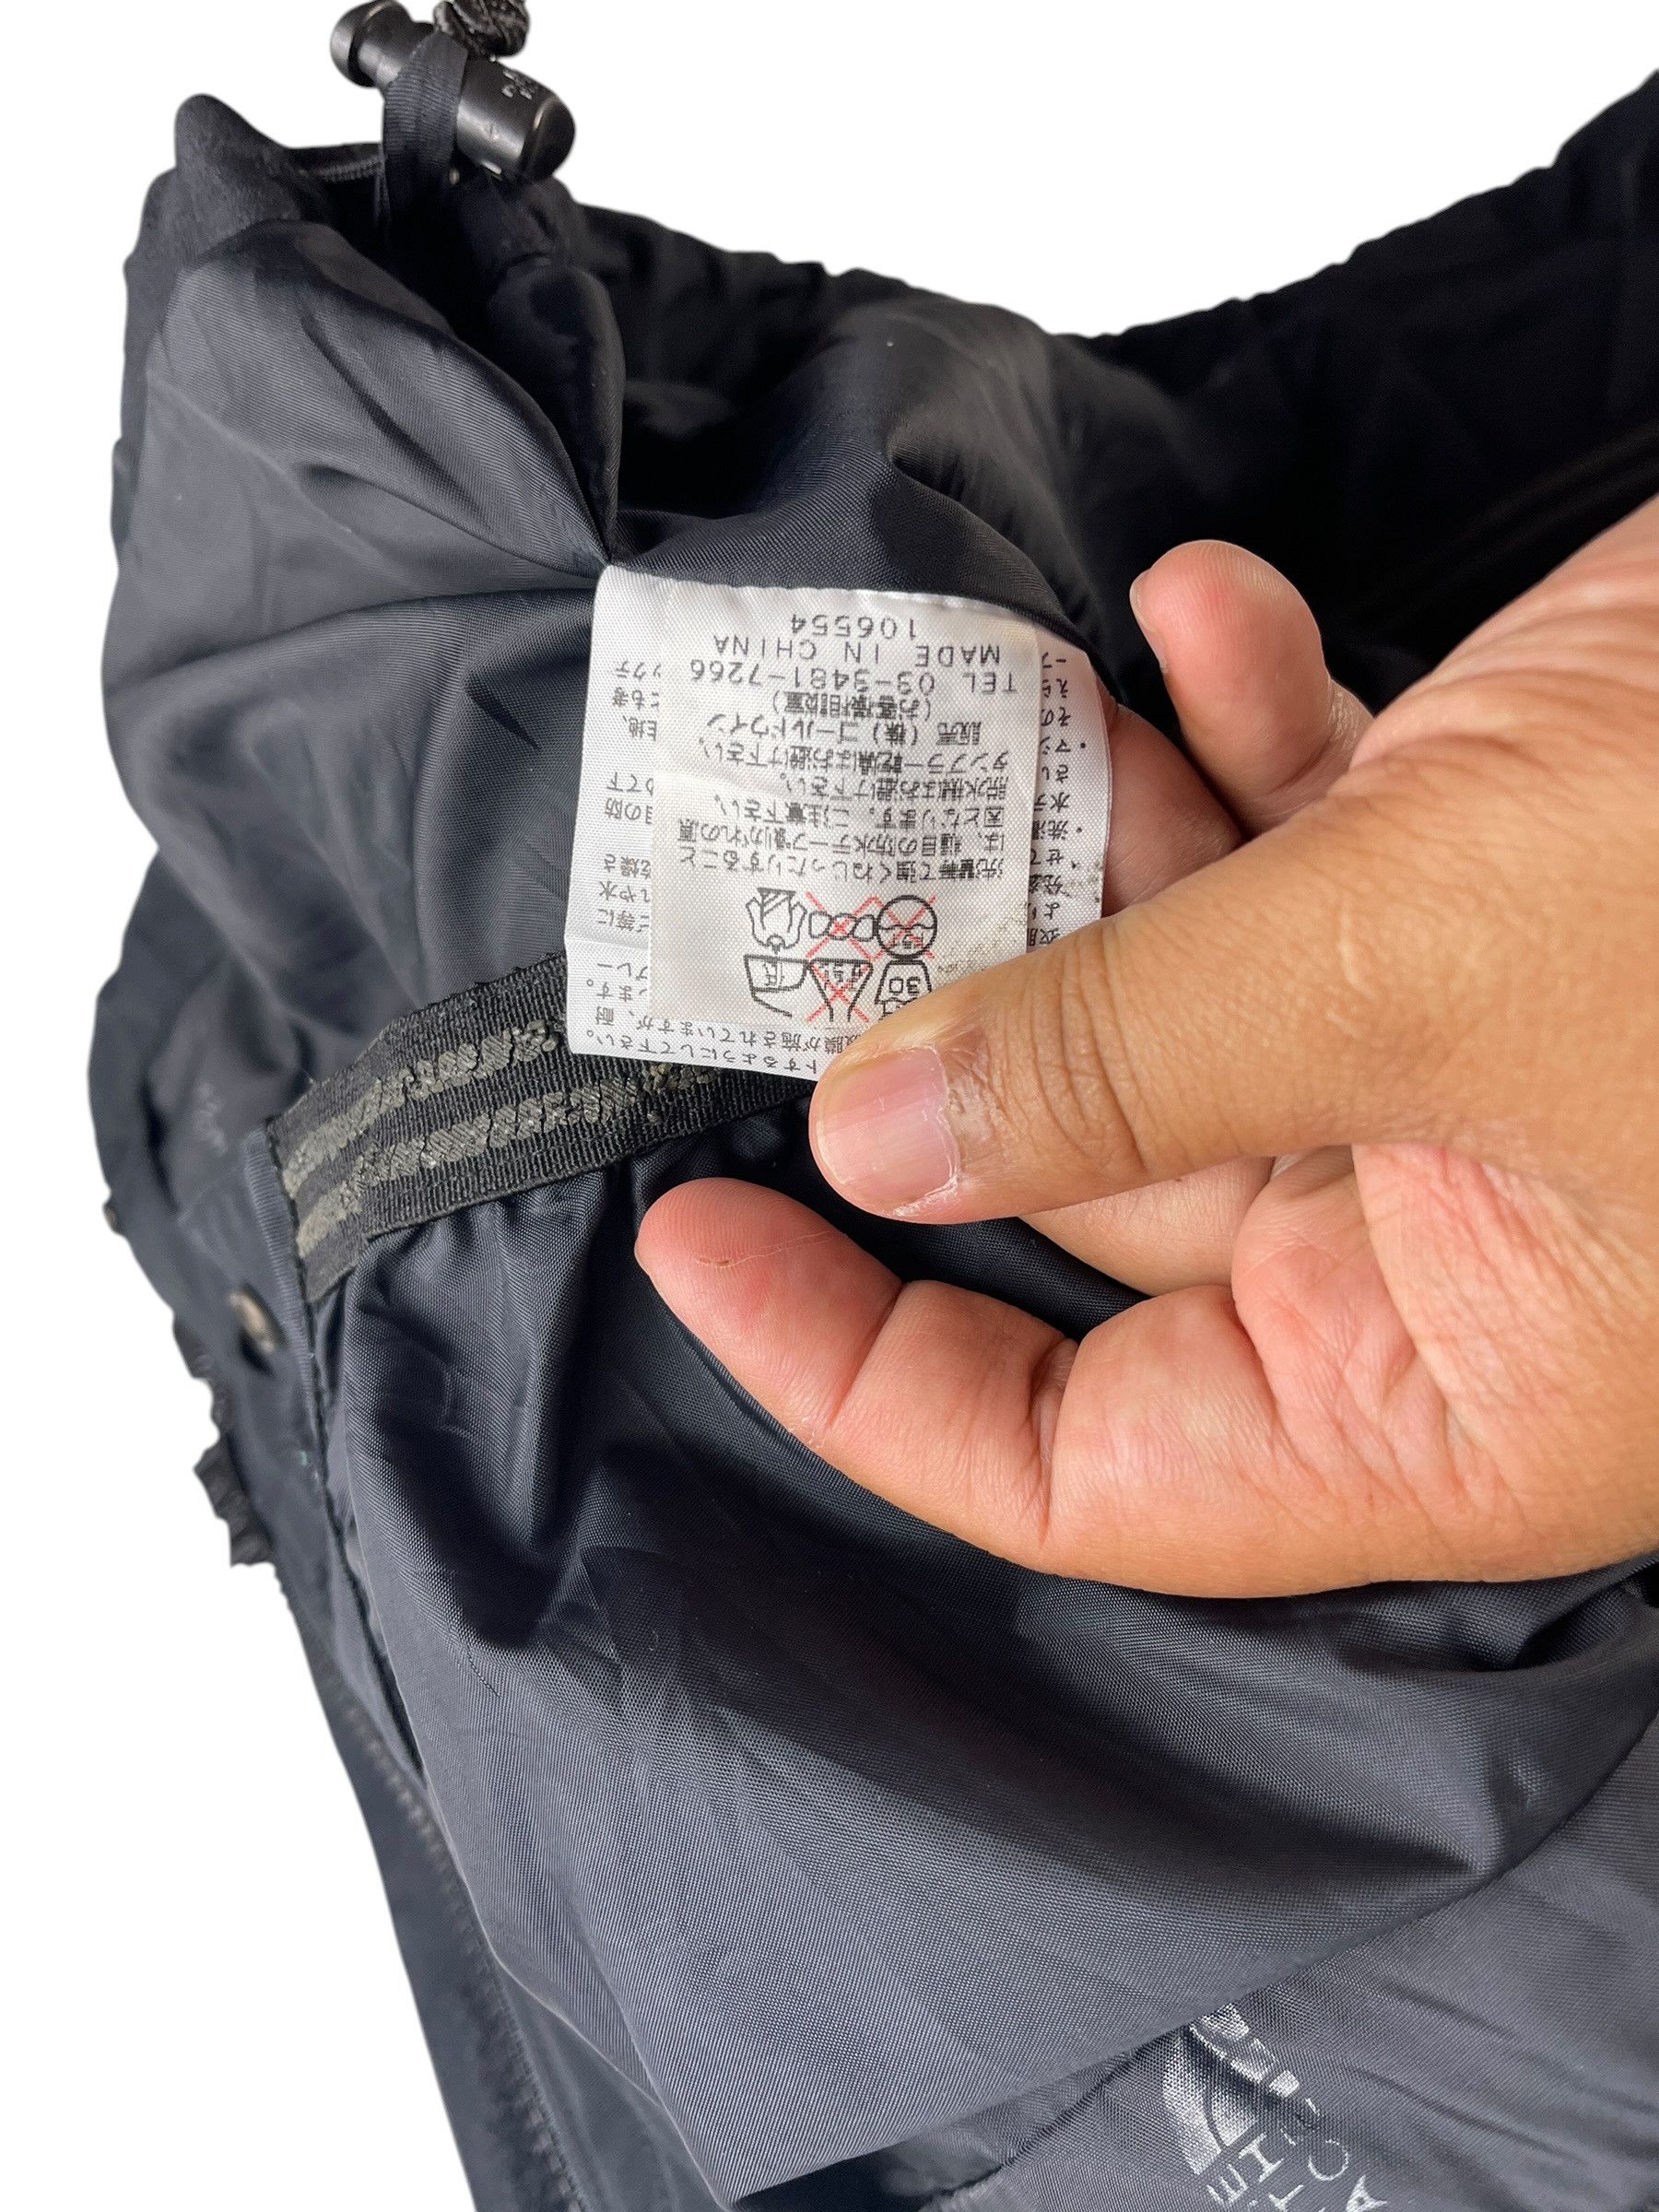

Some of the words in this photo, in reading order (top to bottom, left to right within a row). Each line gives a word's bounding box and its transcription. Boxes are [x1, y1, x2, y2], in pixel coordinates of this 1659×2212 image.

[791, 612, 916, 641] 106554
[713, 634, 818, 661] CHINA
[844, 641, 880, 664] IN
[915, 644, 1001, 667] MADE
[690, 658, 935, 696] 03-3481-7266
[962, 671, 1016, 695] TEL
[888, 975, 922, 995] 30
